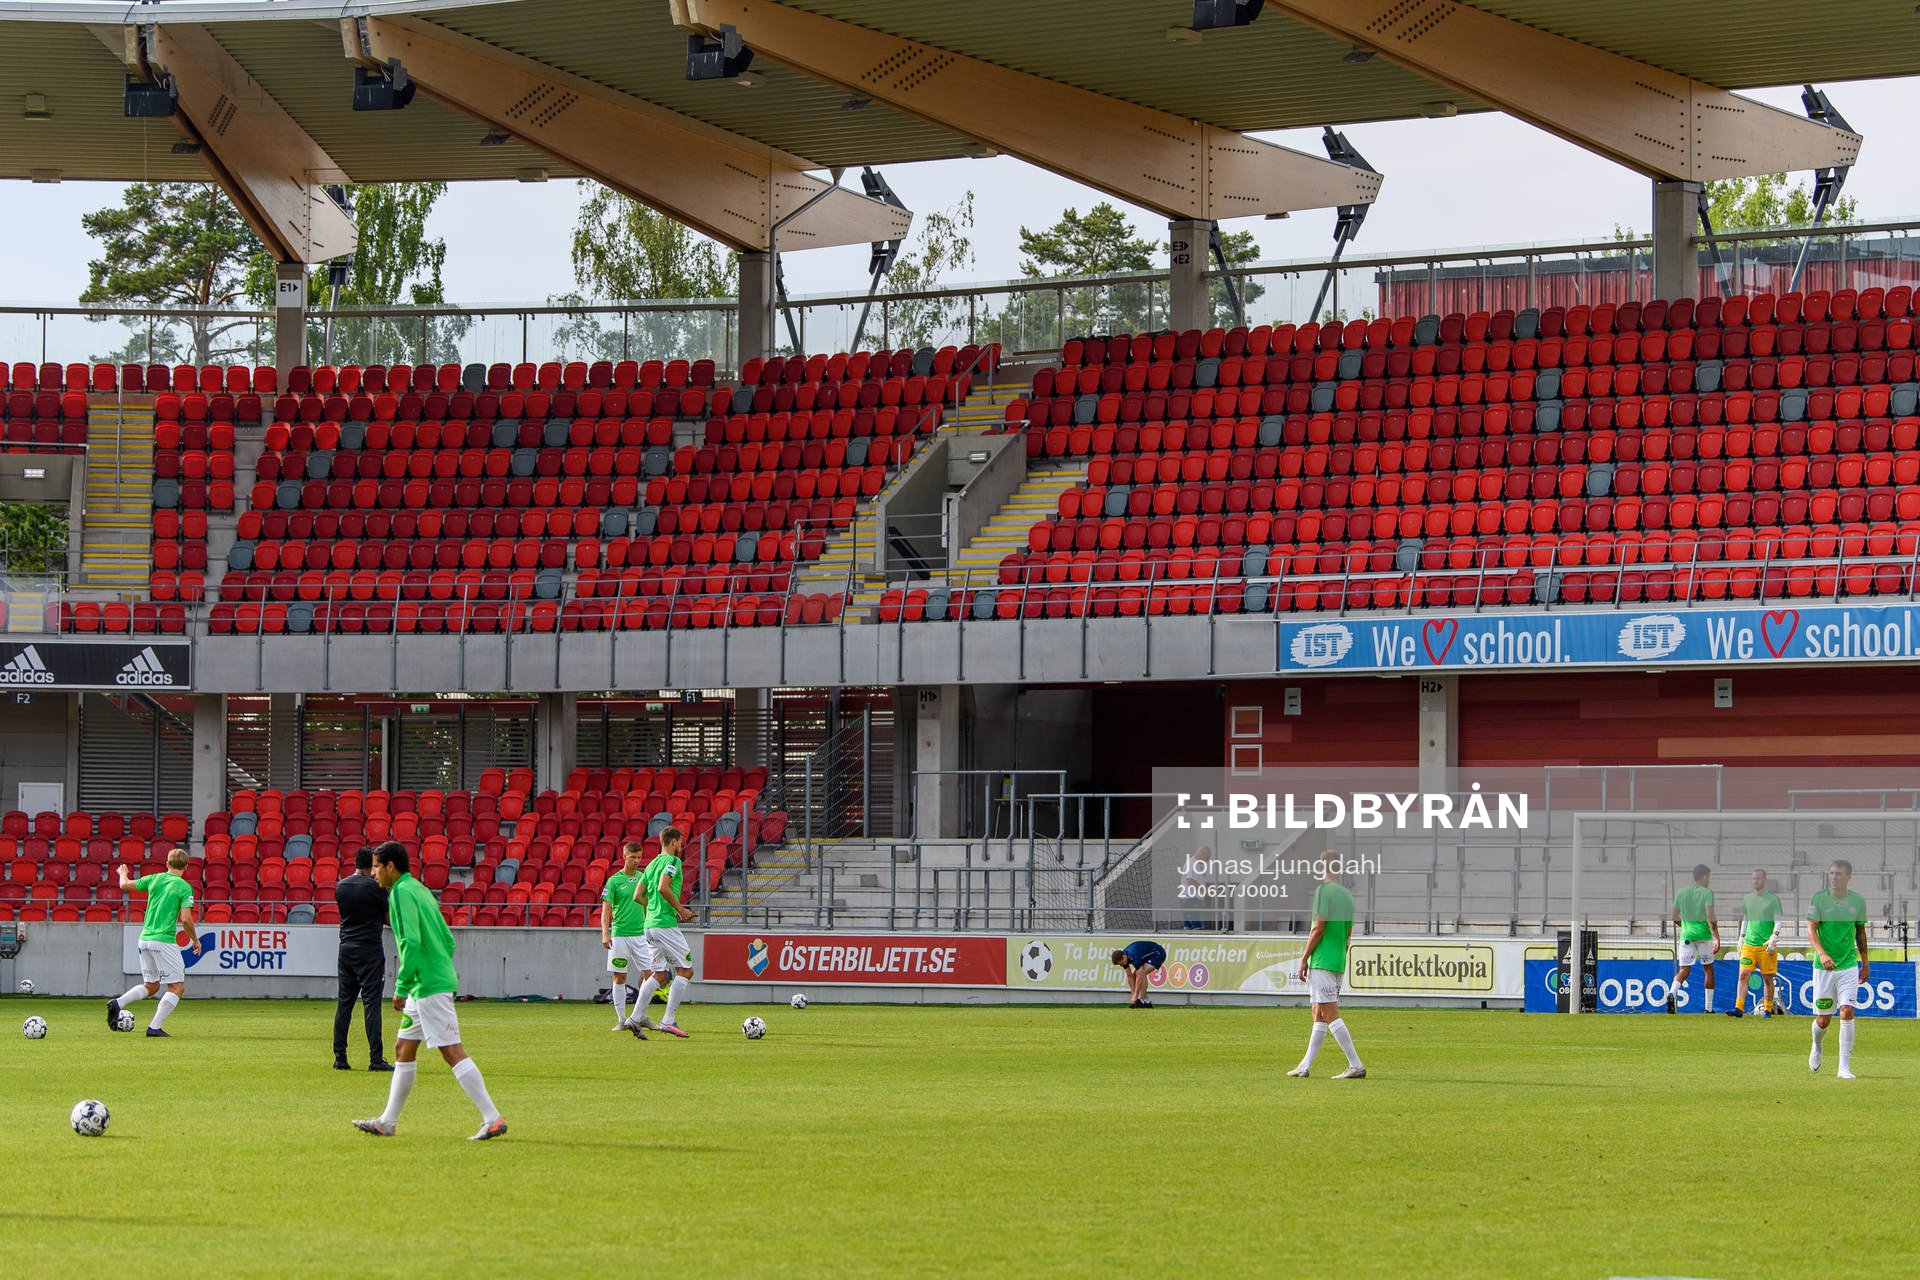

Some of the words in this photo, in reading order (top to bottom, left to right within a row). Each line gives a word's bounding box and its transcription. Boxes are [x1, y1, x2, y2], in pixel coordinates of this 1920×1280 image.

[1173, 241, 1184, 251] E3
[1178, 255, 1190, 264] E2
[280, 282, 291, 292] E1
[1372, 625, 1416, 667] We
[1463, 619, 1571, 664] school.
[1633, 624, 1675, 649] IST
[1706, 617, 1754, 659] We
[1805, 610, 1920, 658] school.
[1304, 632, 1343, 657] IST
[0, 668, 55, 684] adidas
[116, 671, 173, 685] adidas
[1421, 682, 1436, 693] H2
[17, 693, 30, 704] F2
[686, 692, 696, 703] F1
[219, 951, 287, 969] SPORT
[779, 940, 957, 973] ÖSTERBILJETT.SE
[1063, 943, 1083, 960] Ta
[1174, 944, 1248, 962] matchen
[1063, 963, 1099, 981] med
[1173, 968, 1183, 982] 4
[1194, 968, 1204, 983] 8
[1355, 953, 1487, 982] arkitektkopia
[1599, 978, 1690, 1007] OBOS
[1799, 980, 1895, 1010] OOS
